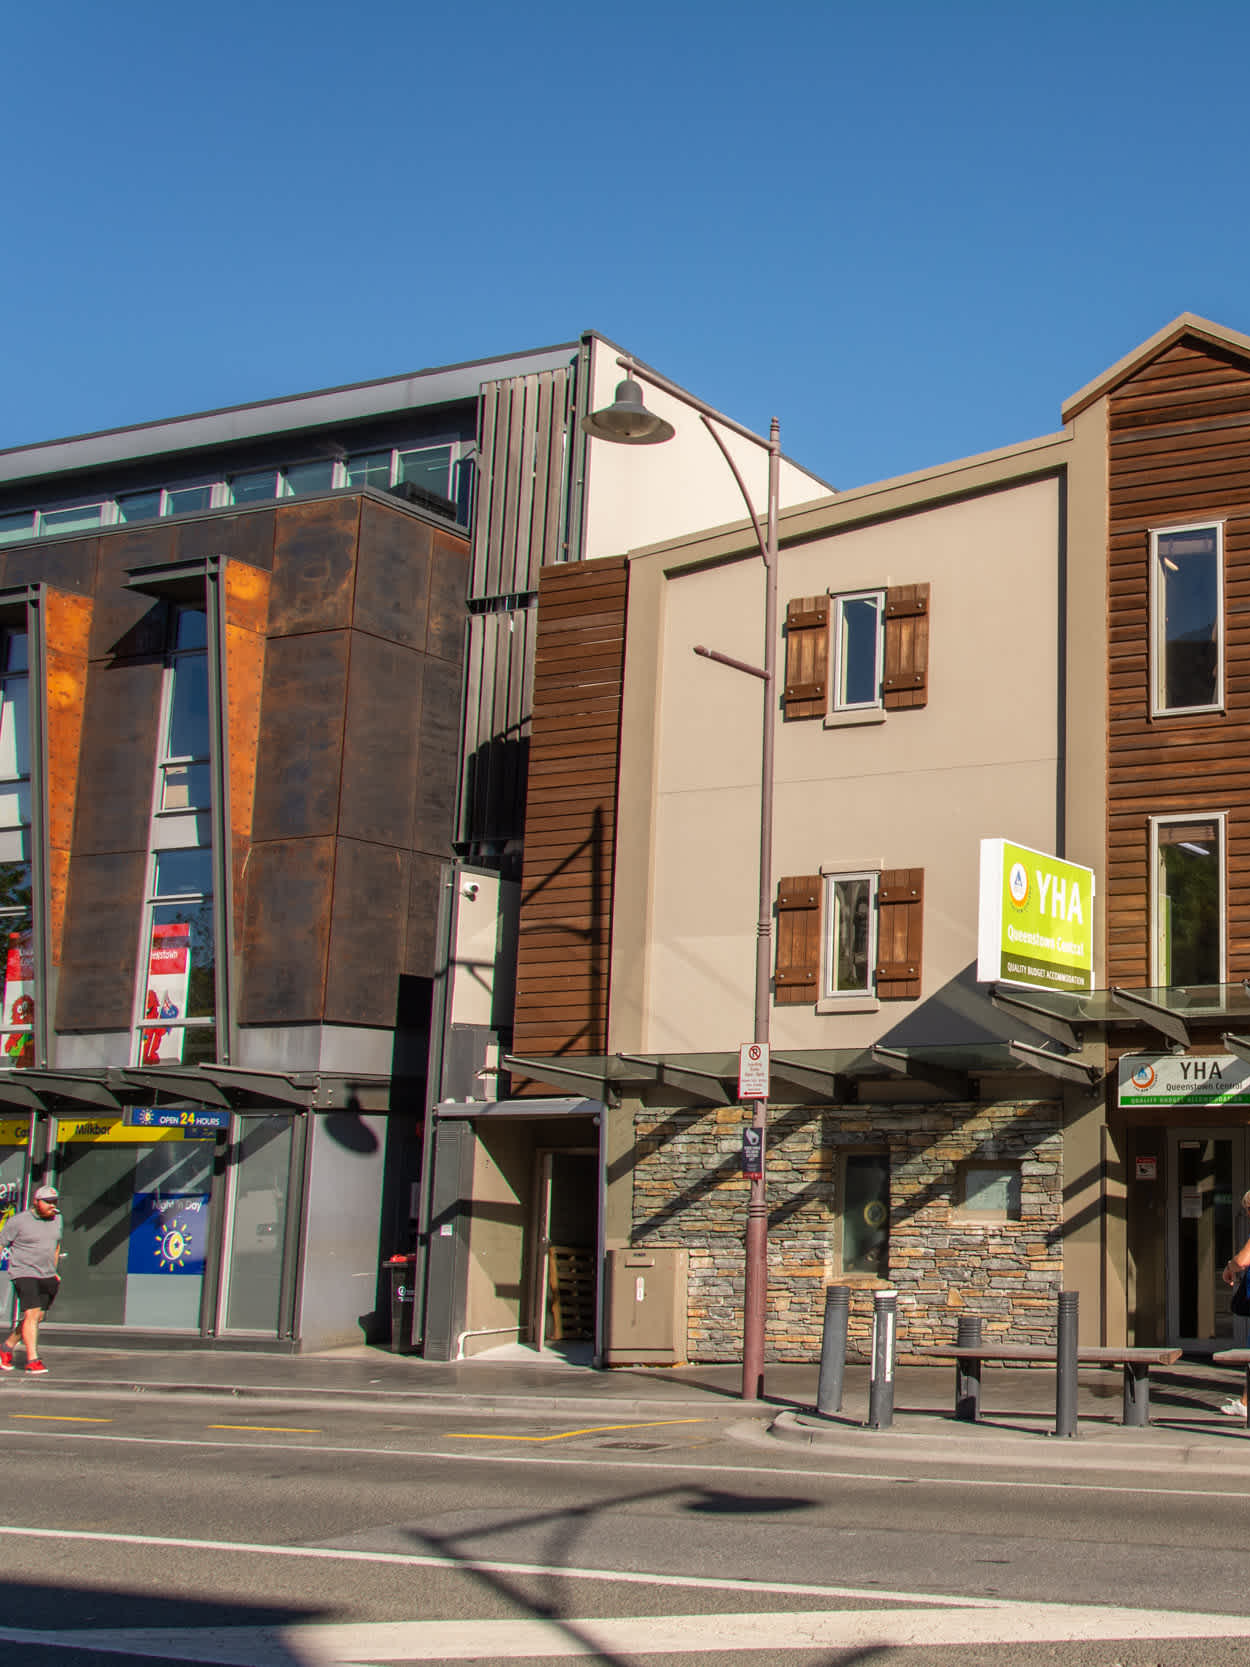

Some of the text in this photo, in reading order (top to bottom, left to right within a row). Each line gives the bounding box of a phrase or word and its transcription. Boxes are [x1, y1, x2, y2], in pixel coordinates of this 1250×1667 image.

[1036, 869, 1084, 926] YHA
[1008, 924, 1085, 957] Queenstown Central
[1008, 962, 1086, 986] QUALITY BUDGET ACCOMMODATION
[1180, 1062, 1223, 1080] YHA
[1166, 1082, 1213, 1092] Queenstown
[1216, 1081, 1243, 1091] Central
[160, 1111, 221, 1126] OPEN 24 HOURS
[75, 1123, 112, 1135] Milkbar
[185, 1199, 202, 1213] Day
